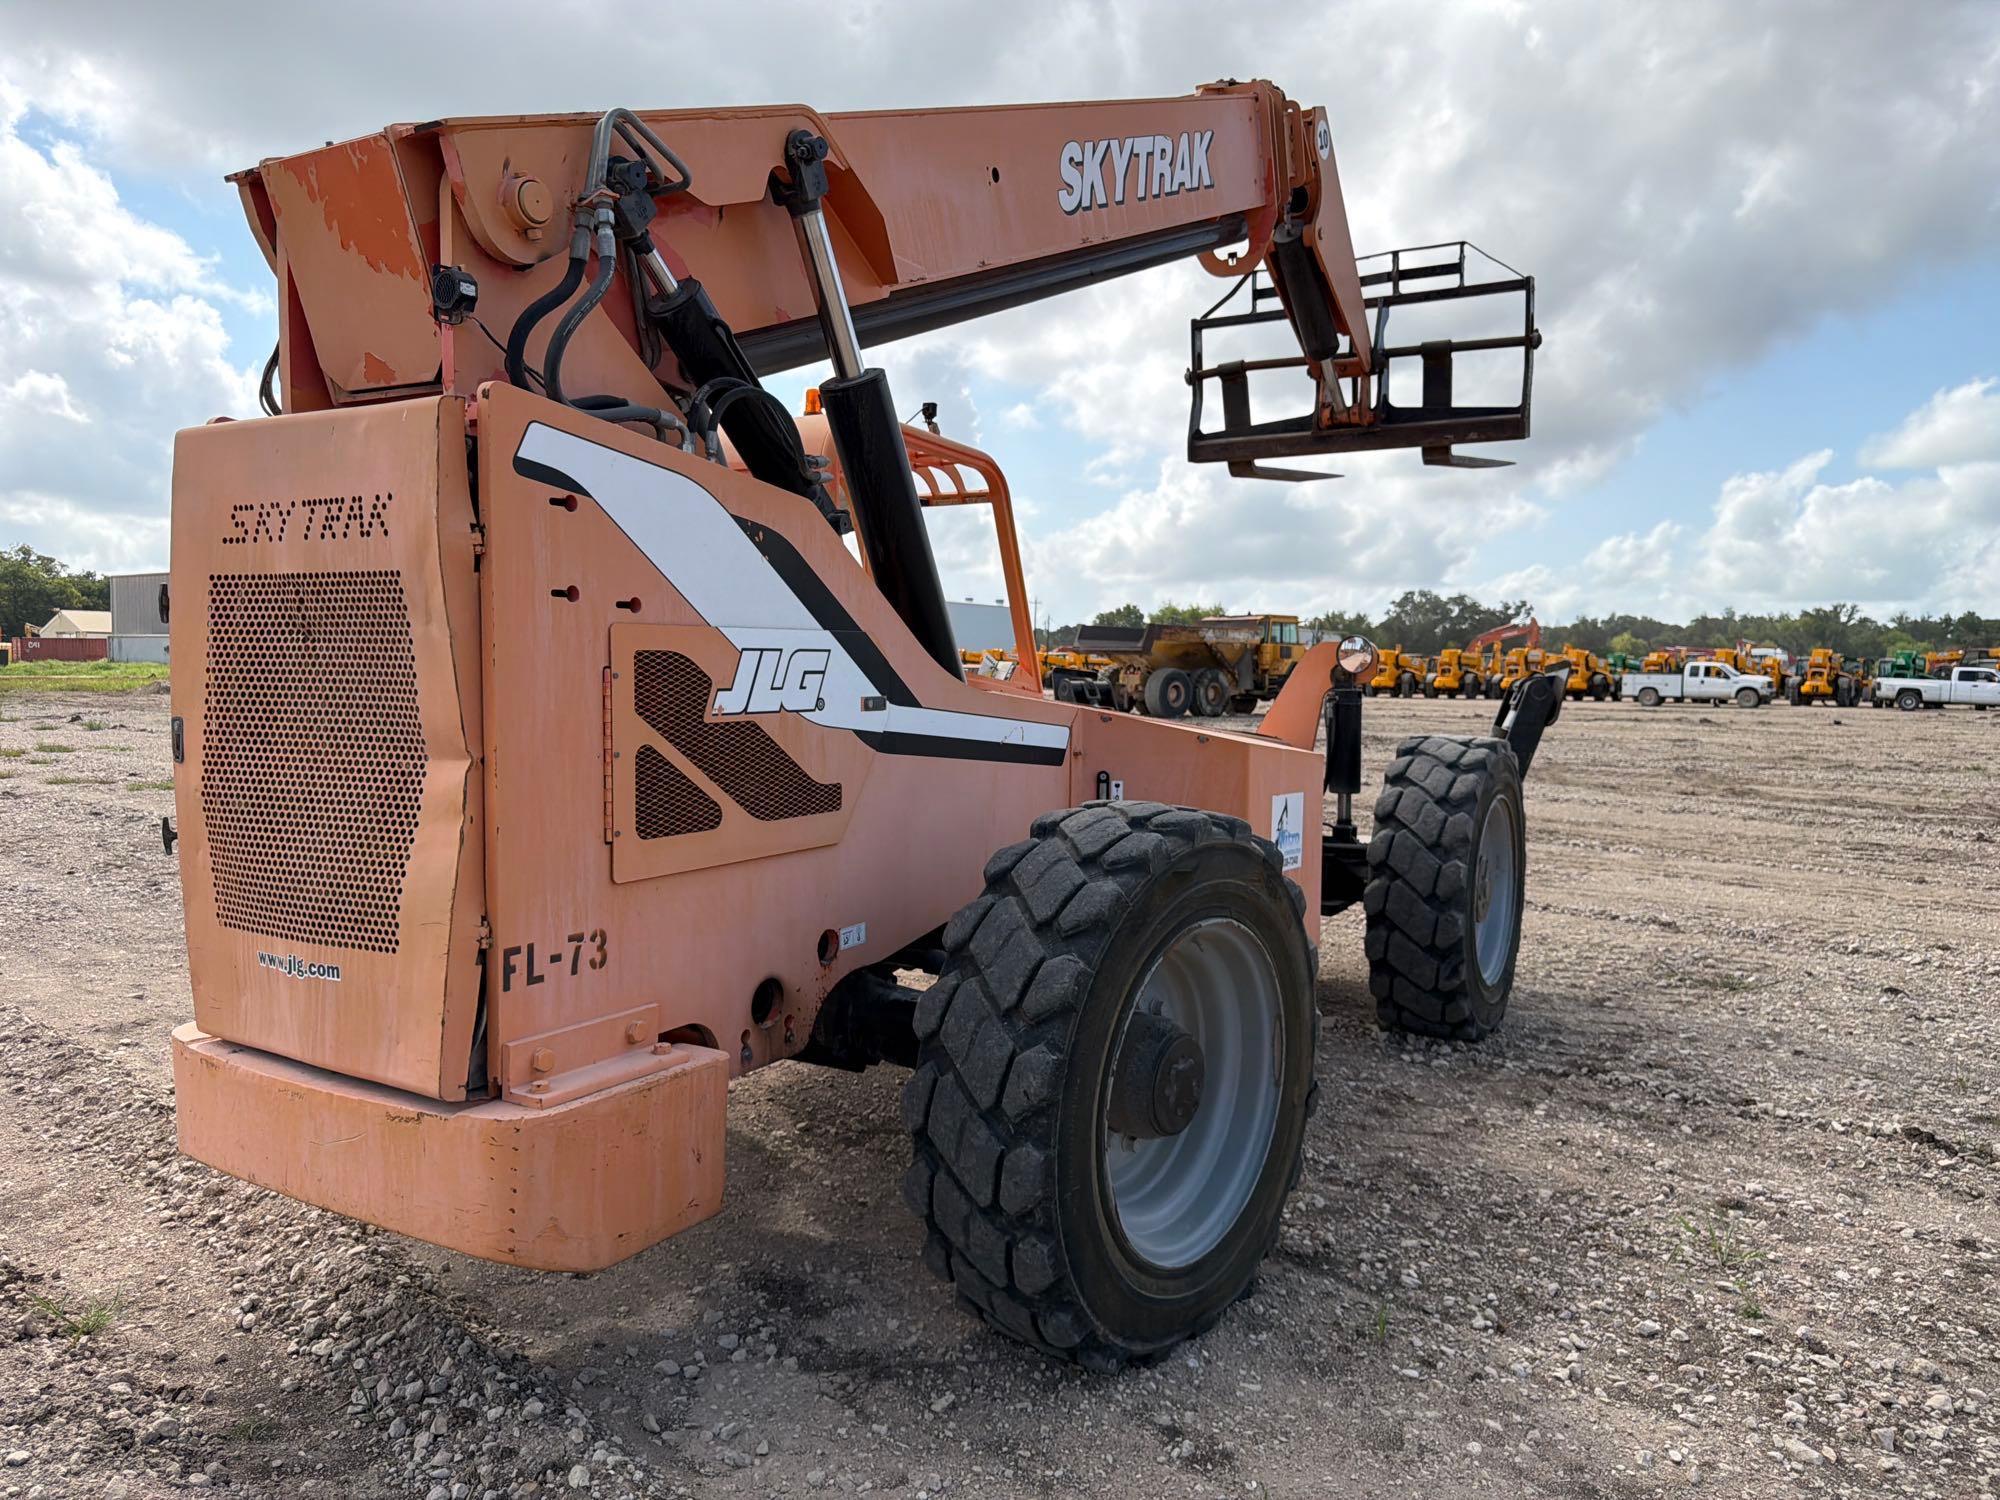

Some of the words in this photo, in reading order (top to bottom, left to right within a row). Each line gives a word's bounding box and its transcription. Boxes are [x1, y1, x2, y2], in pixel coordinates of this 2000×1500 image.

[1318, 128, 1328, 150] 10
[1057, 130, 1214, 216] SKYTRAK
[222, 492, 393, 545] SKYTRAK
[711, 647, 831, 717] JLG
[258, 951, 341, 979] www.jlg.com
[502, 927, 608, 993] FL-73
